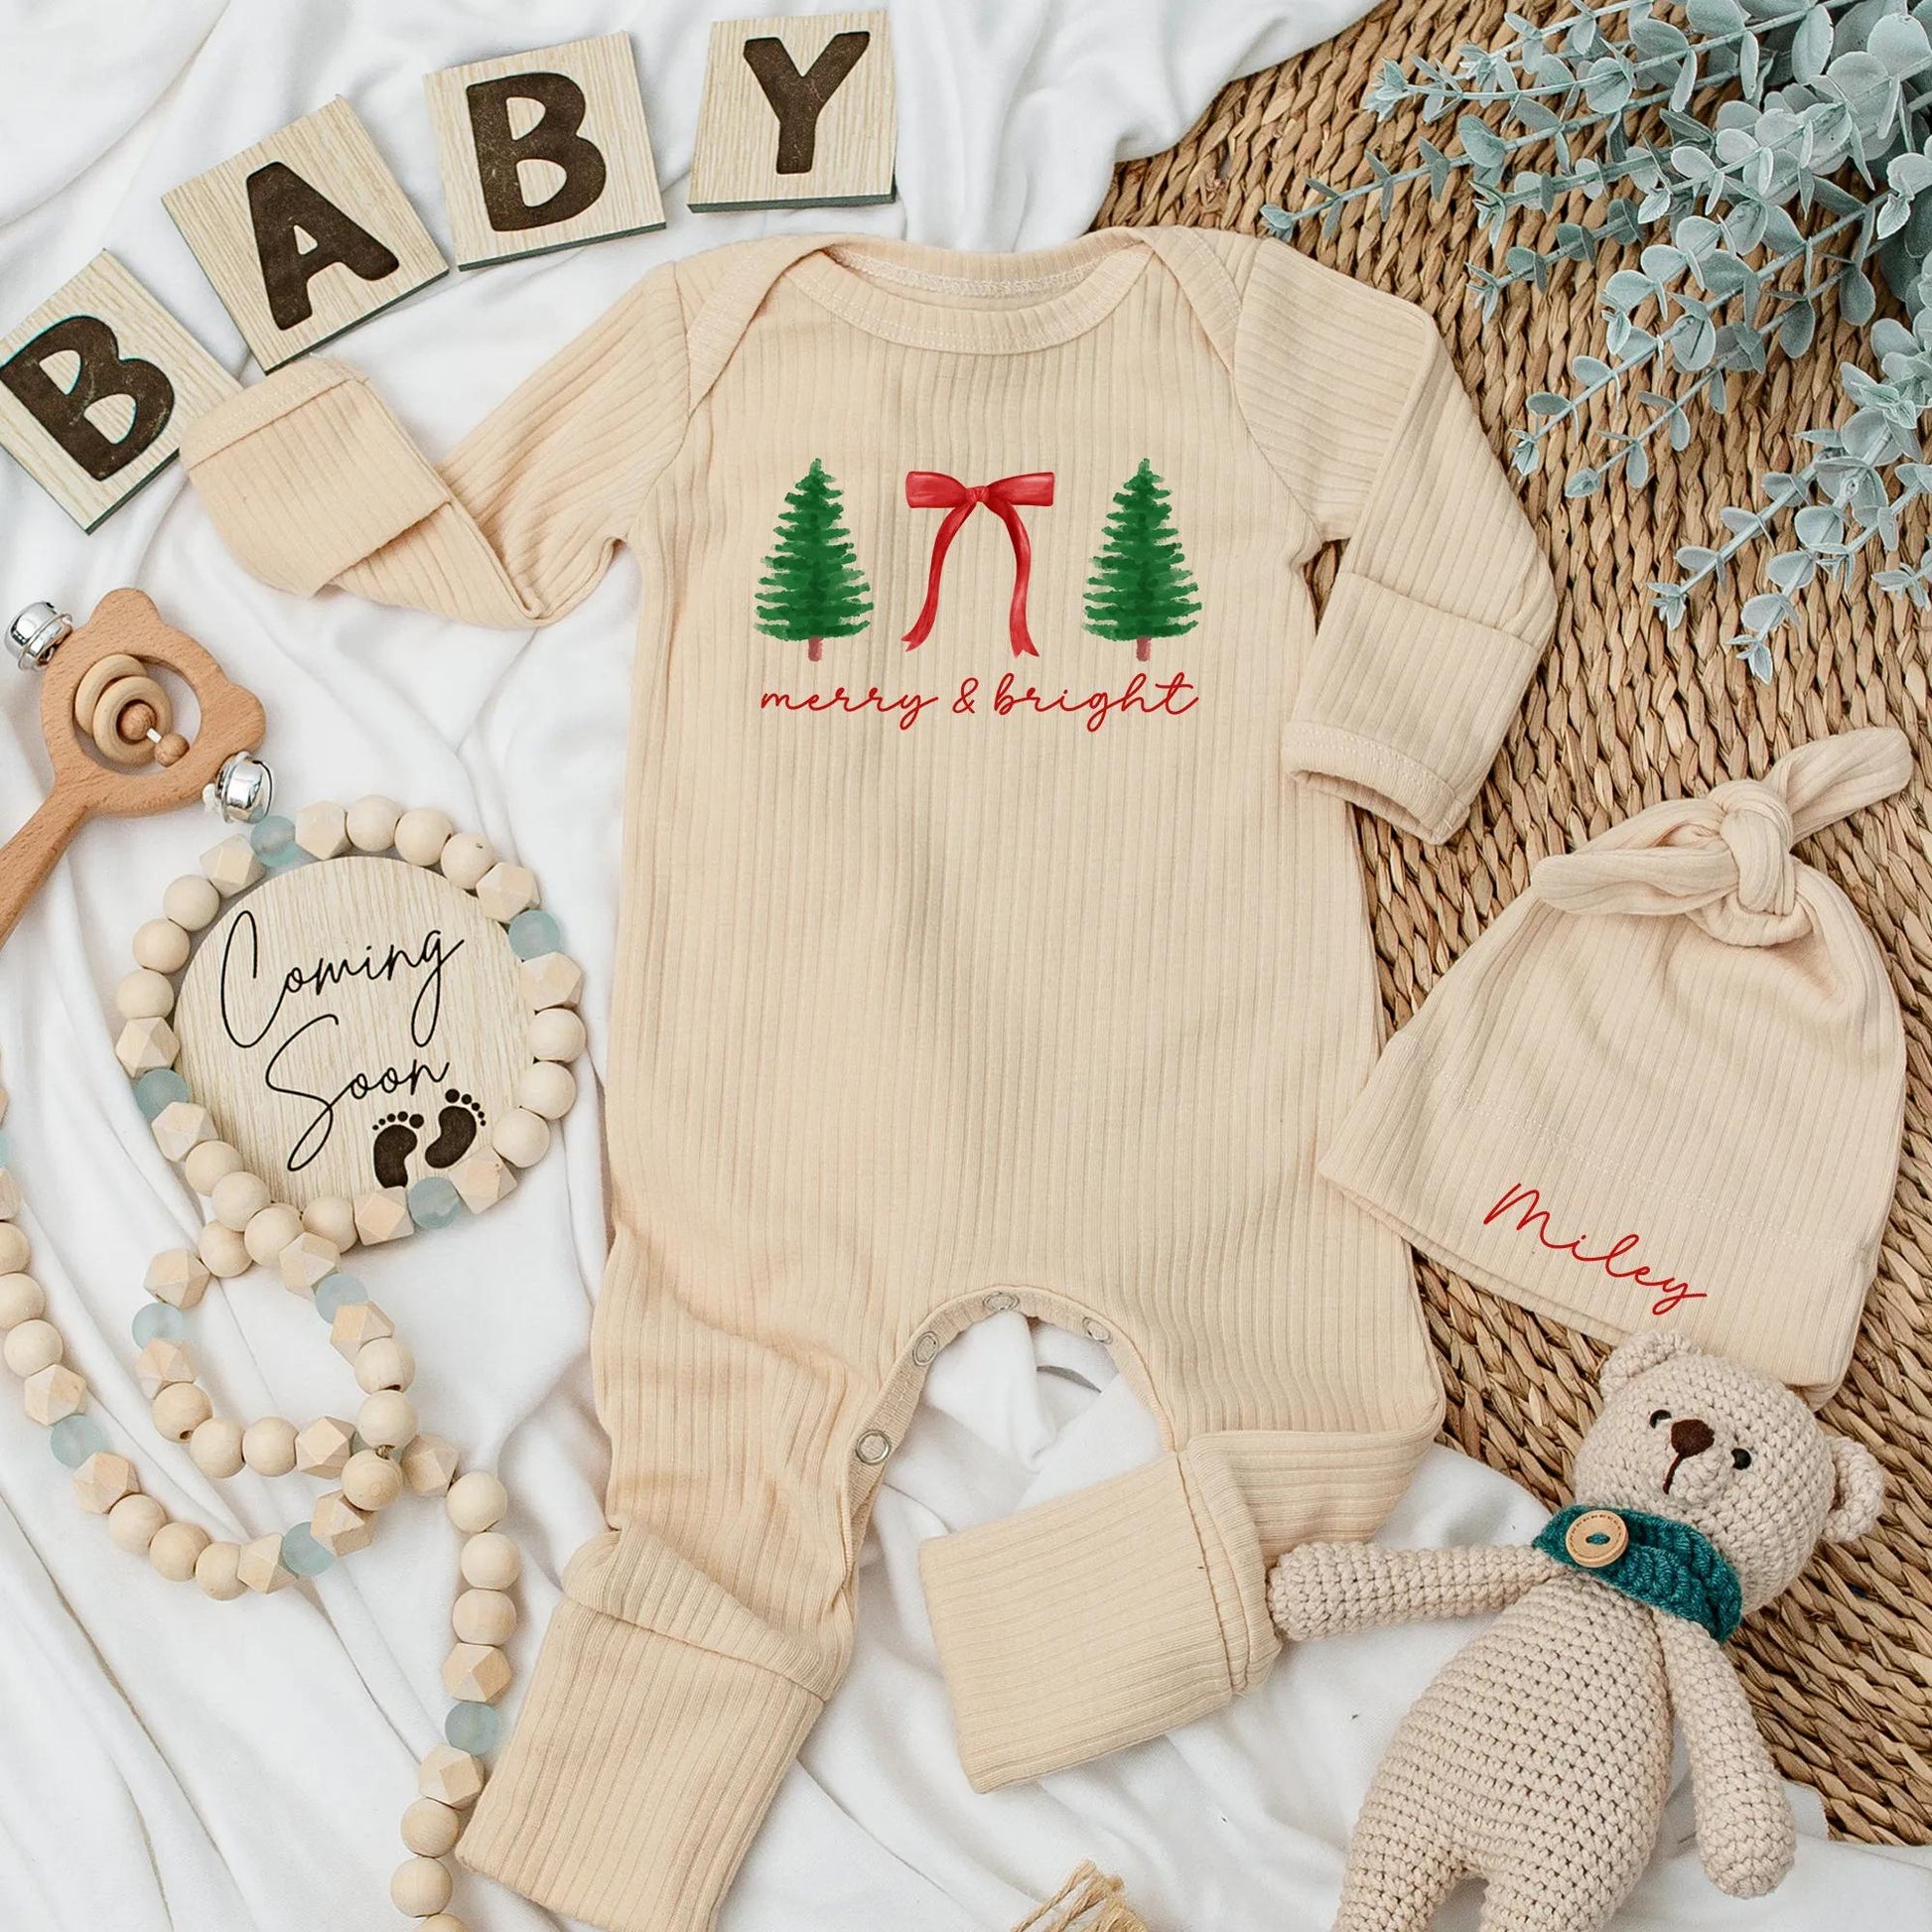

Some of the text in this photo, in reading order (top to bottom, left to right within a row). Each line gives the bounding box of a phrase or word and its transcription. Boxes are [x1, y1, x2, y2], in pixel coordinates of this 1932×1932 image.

[0, 31, 871, 483] BABY
[759, 671, 1200, 733] merry & bright
[219, 909, 465, 1048] Coming
[265, 1013, 450, 1173] Soon
[1482, 1182, 1708, 1316] Miley
